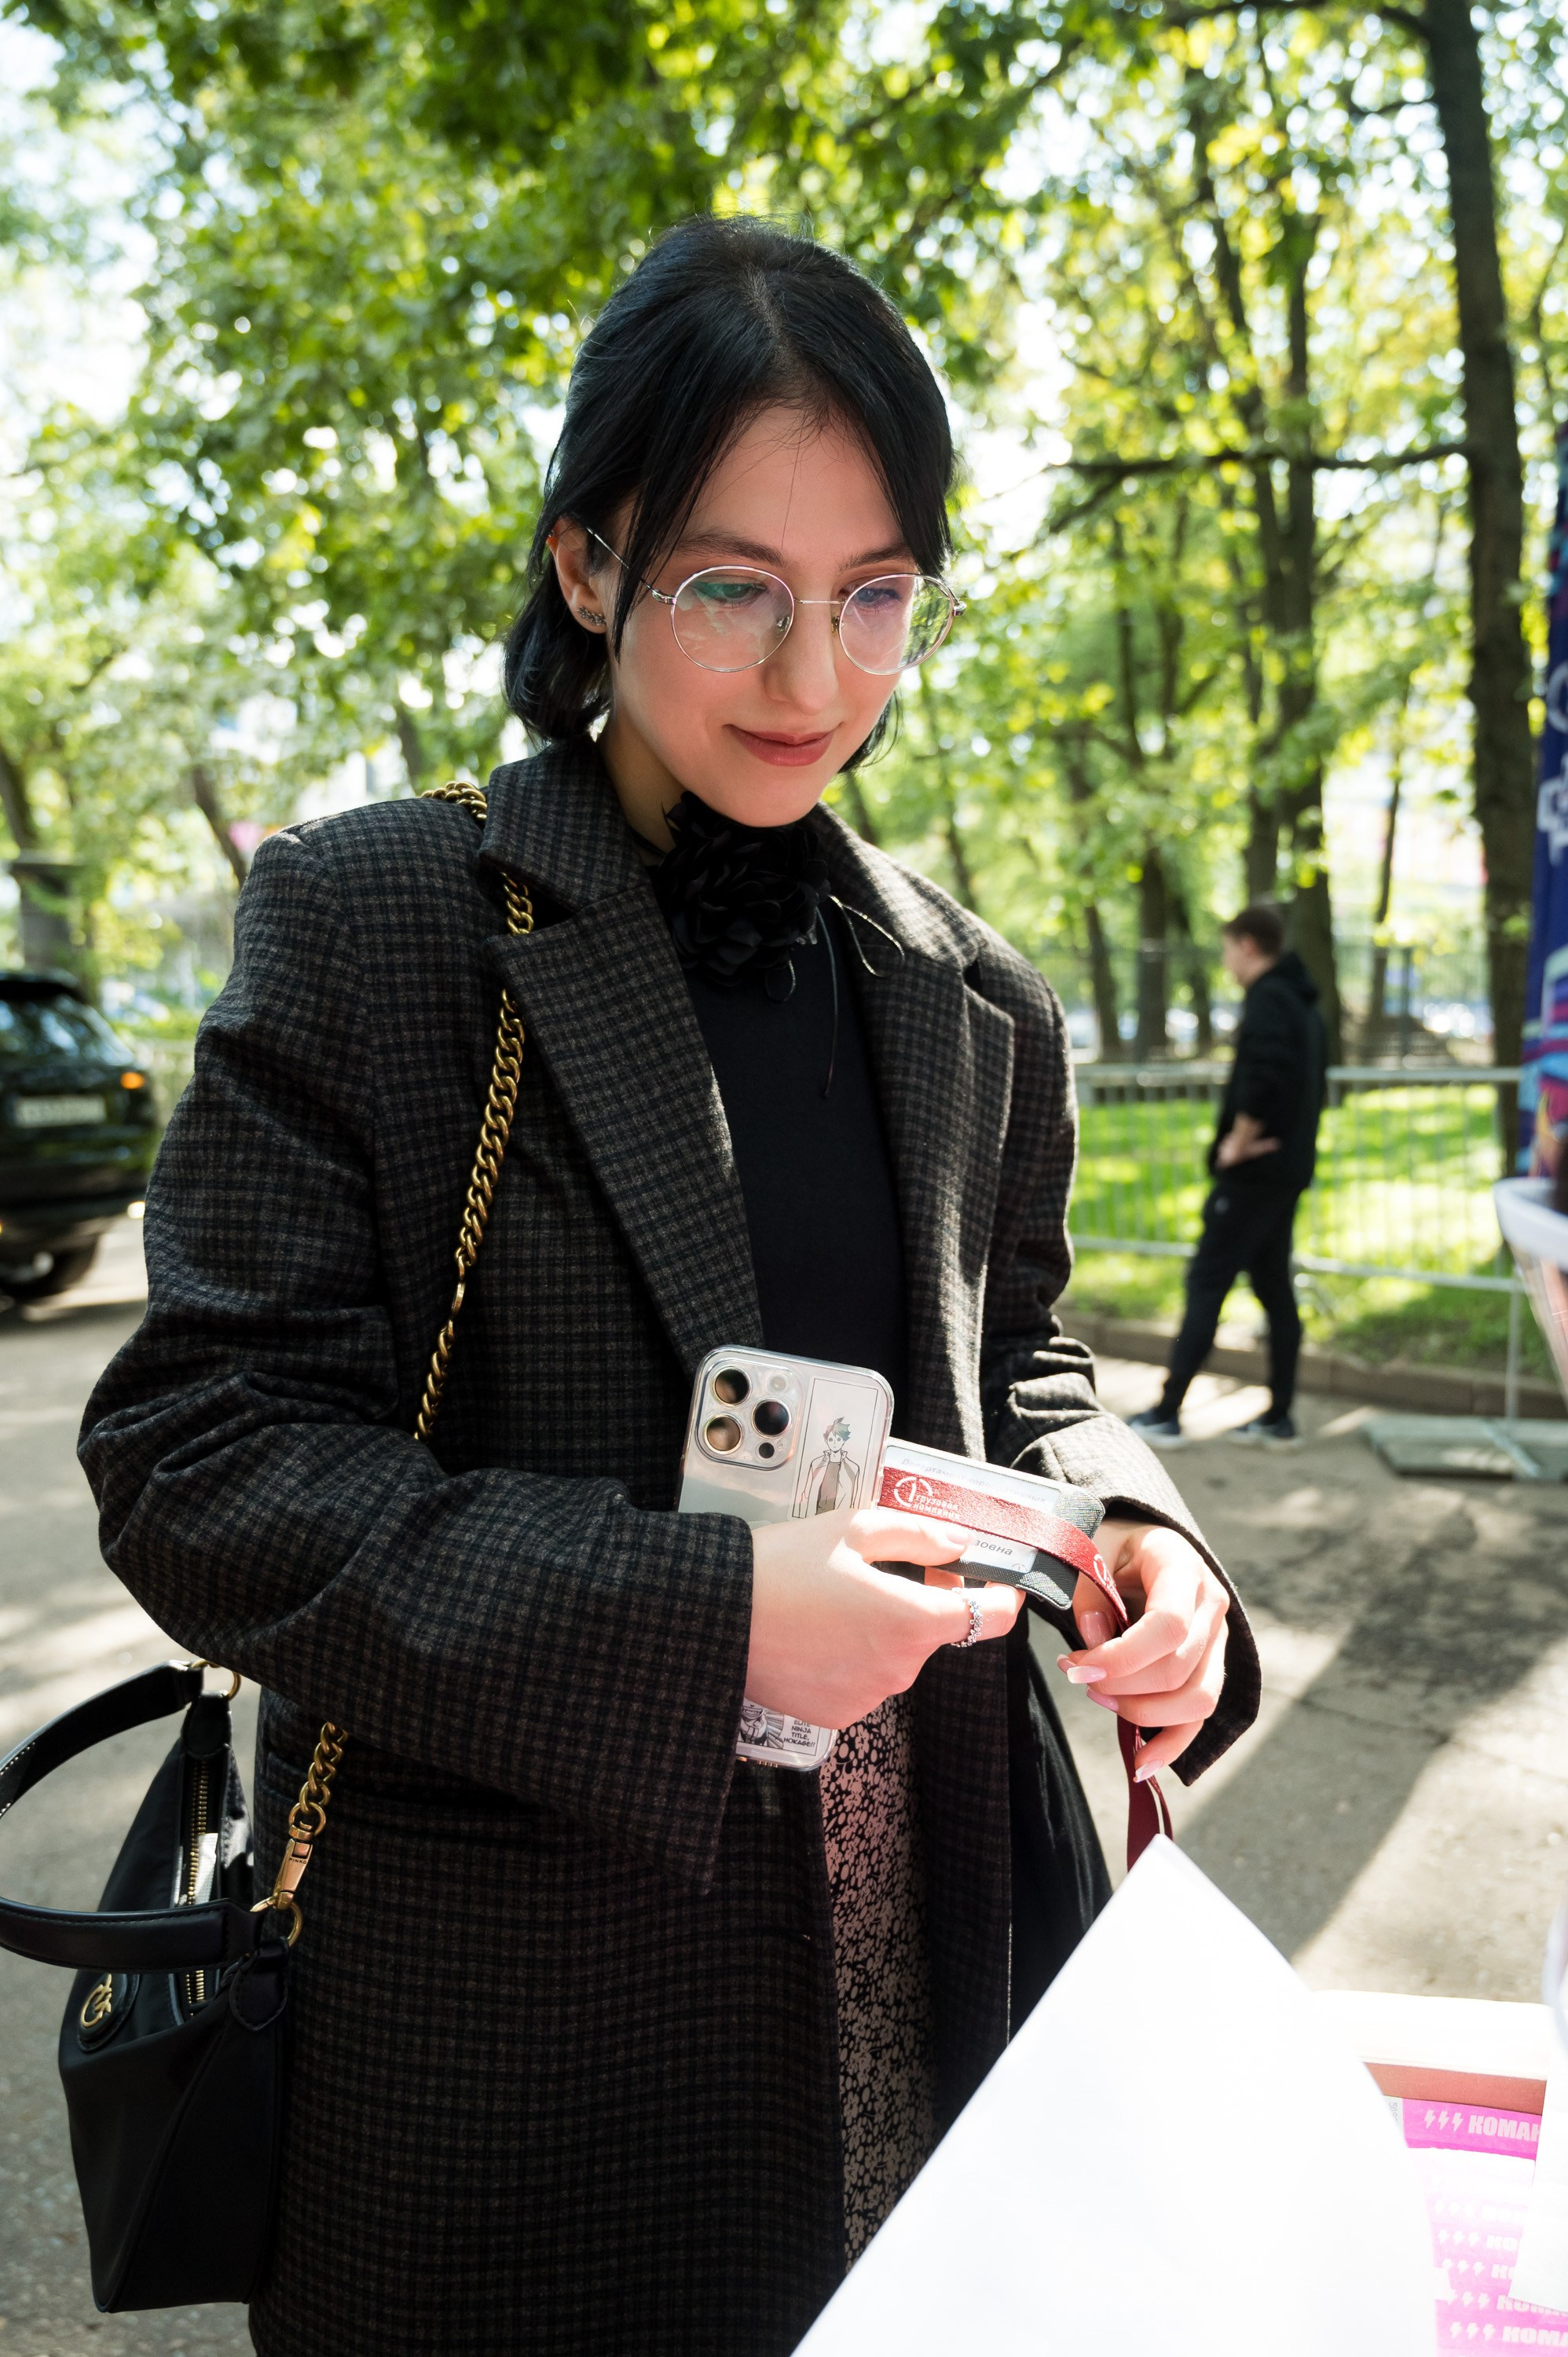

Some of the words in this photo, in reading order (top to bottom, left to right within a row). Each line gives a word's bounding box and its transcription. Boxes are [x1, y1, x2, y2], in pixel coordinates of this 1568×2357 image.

[913, 1501, 961, 1519] компания
[973, 1538, 1013, 1556] зовна
[784, 1737, 815, 1747] HOKAGE!!
